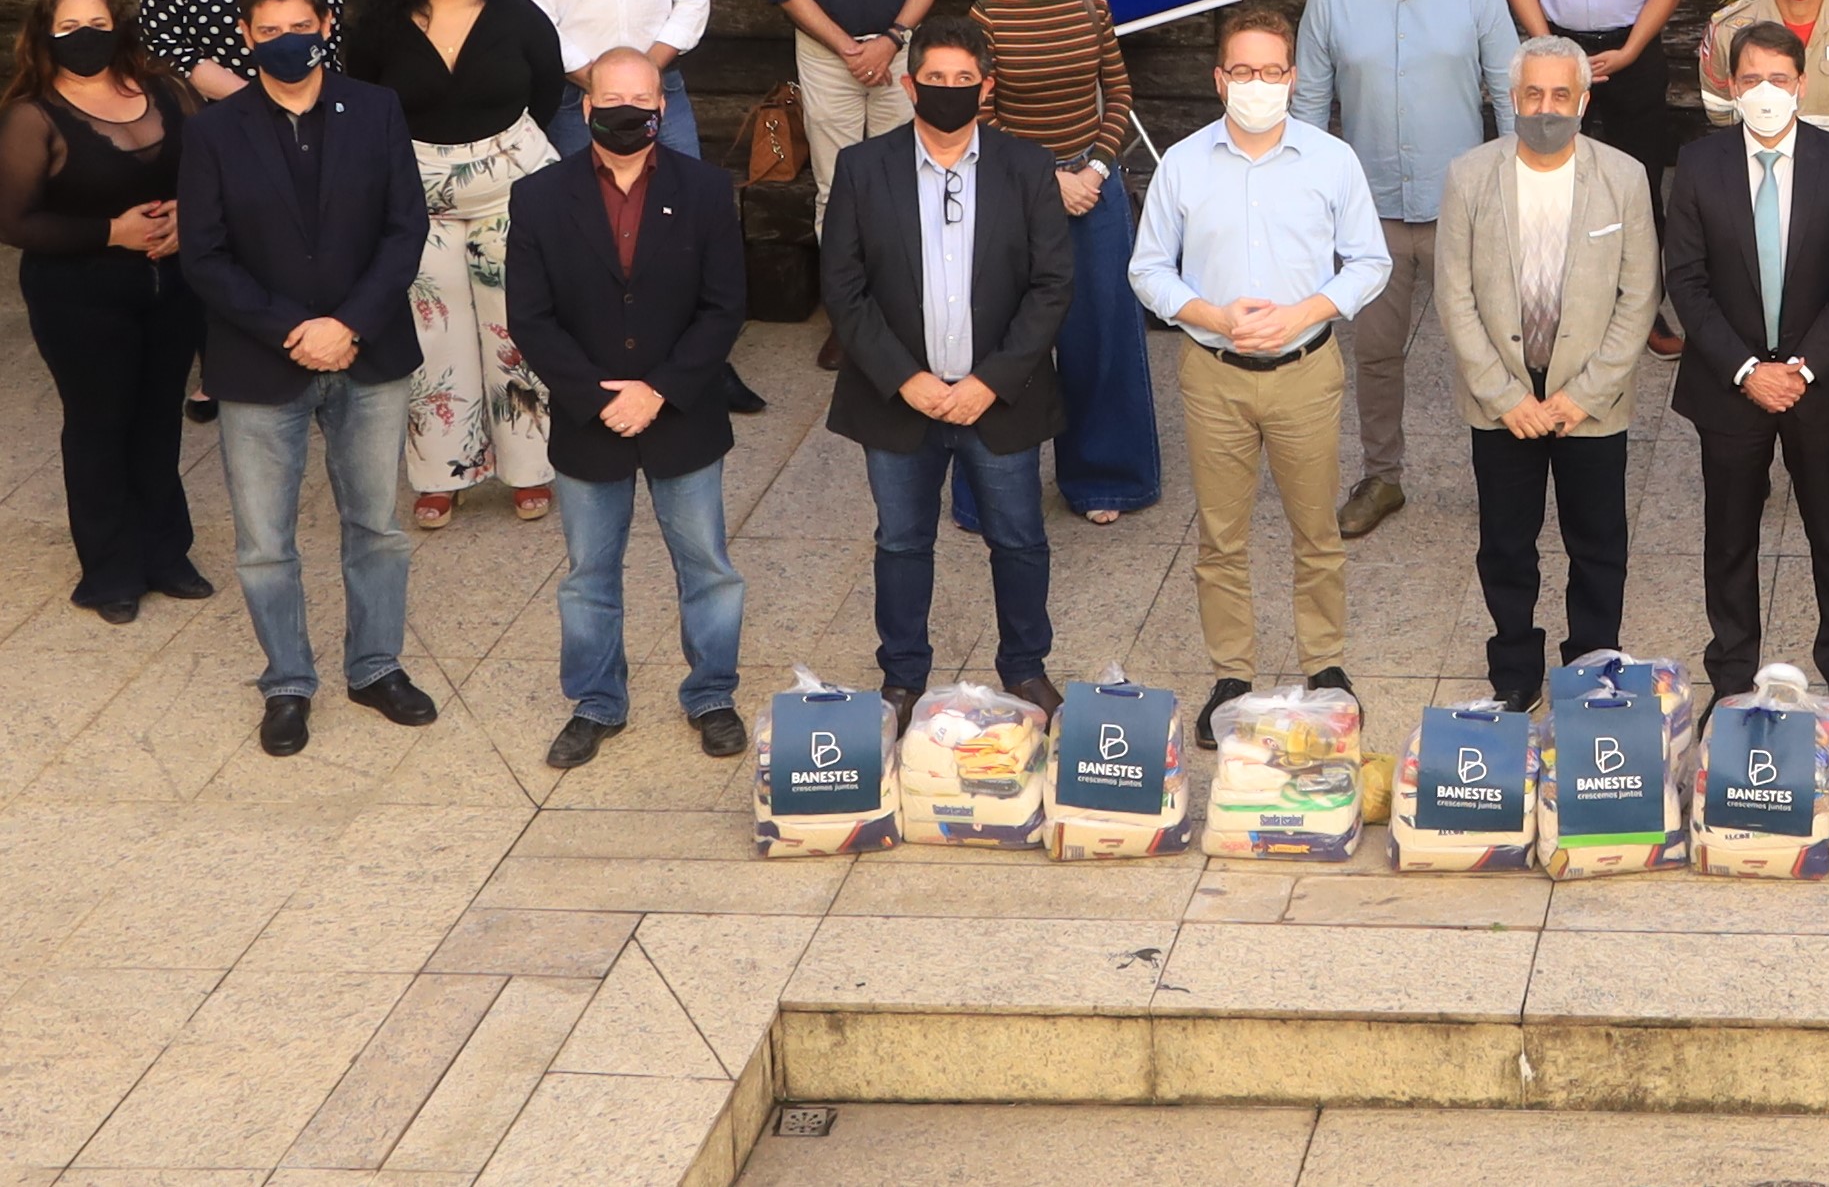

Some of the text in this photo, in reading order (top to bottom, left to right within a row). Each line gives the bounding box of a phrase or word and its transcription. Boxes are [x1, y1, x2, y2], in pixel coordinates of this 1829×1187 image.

[791, 770, 859, 784] BANESTES
[1077, 761, 1143, 779] BANESTES
[1576, 775, 1643, 791] BANESTES
[1436, 785, 1502, 801] BANESTES
[1726, 787, 1792, 803] BANESTES
